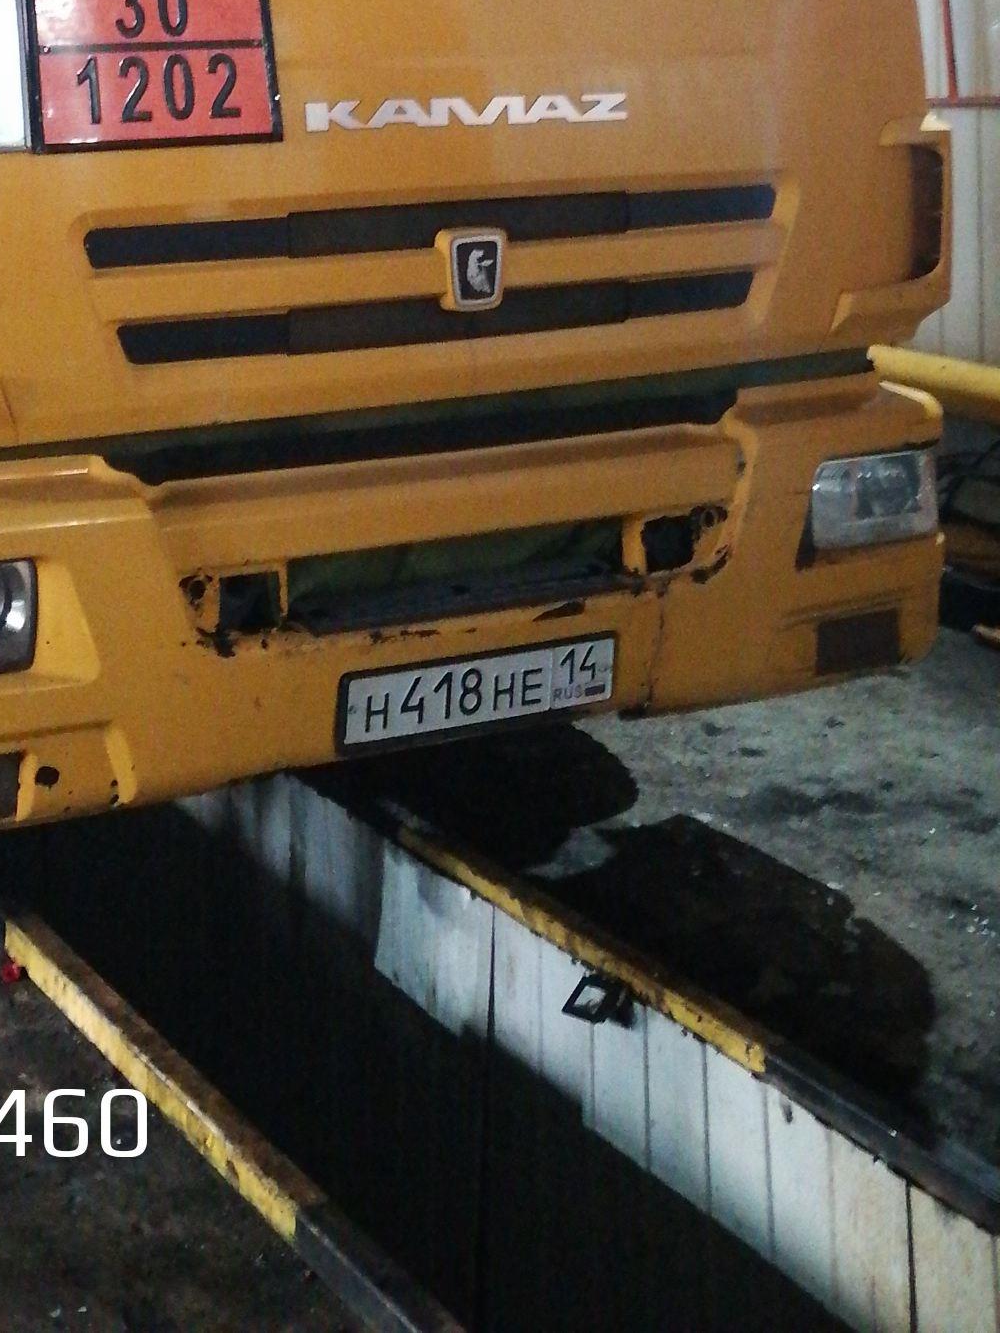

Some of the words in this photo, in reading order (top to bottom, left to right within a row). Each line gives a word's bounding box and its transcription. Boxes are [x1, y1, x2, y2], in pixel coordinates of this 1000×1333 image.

[76, 52, 242, 125] 1202
[304, 92, 628, 132] KAMAZ
[560, 644, 597, 684] 14
[553, 684, 583, 701] RUS
